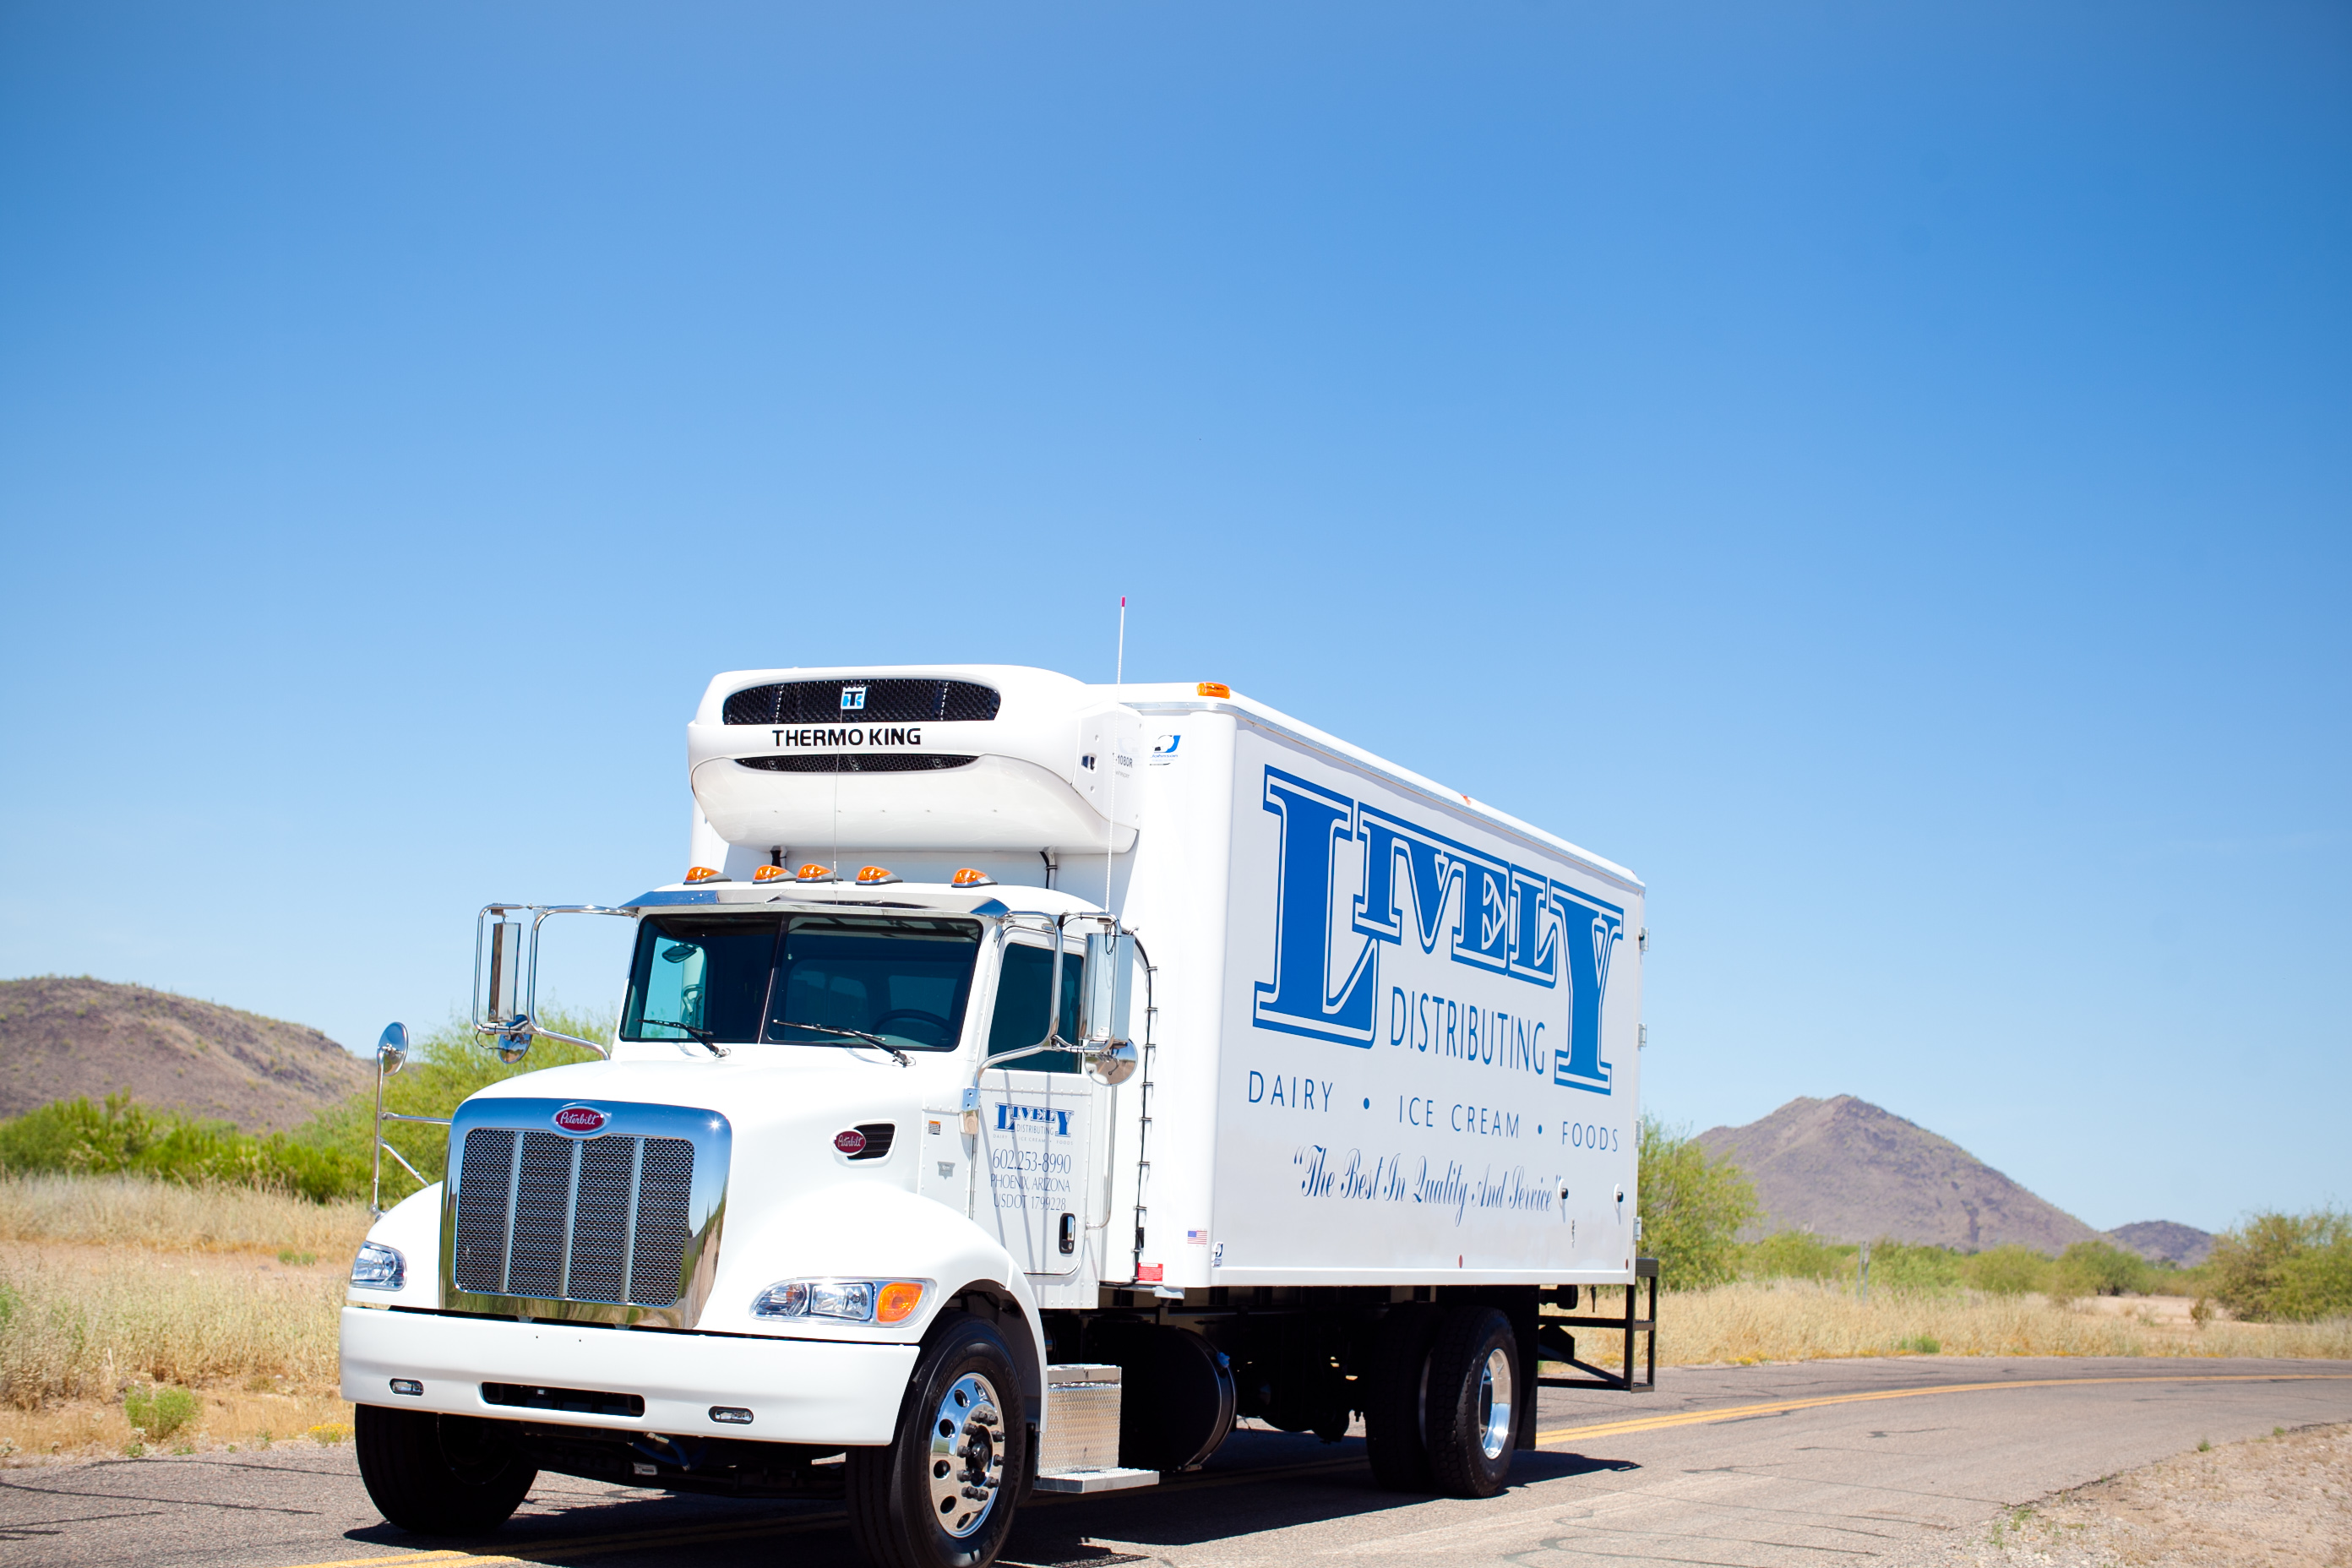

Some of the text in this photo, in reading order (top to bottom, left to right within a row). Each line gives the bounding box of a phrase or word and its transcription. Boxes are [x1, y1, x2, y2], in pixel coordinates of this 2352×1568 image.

[772, 727, 921, 747] THERMO KING
[1253, 764, 1624, 1096] LIVELY
[1391, 986, 1545, 1075] DISTRIBUTING
[560, 1111, 599, 1125] Peterbilt
[994, 1102, 1075, 1137] LIVELY
[1249, 1070, 1618, 1152] DAIRY ICE CREAM FOODS
[1016, 1124, 1054, 1135] DISTRIBUTING
[837, 1135, 863, 1148] Peterbilt
[993, 1149, 1071, 1174] 602.253-8990
[990, 1173, 1071, 1192] PHOENIX, ARIZONA
[1340, 1148, 1384, 1200] Best
[1384, 1153, 1406, 1201] In
[1412, 1156, 1467, 1228] Quality
[1472, 1163, 1508, 1208] And
[994, 1193, 1066, 1211] USDOT 1799228
